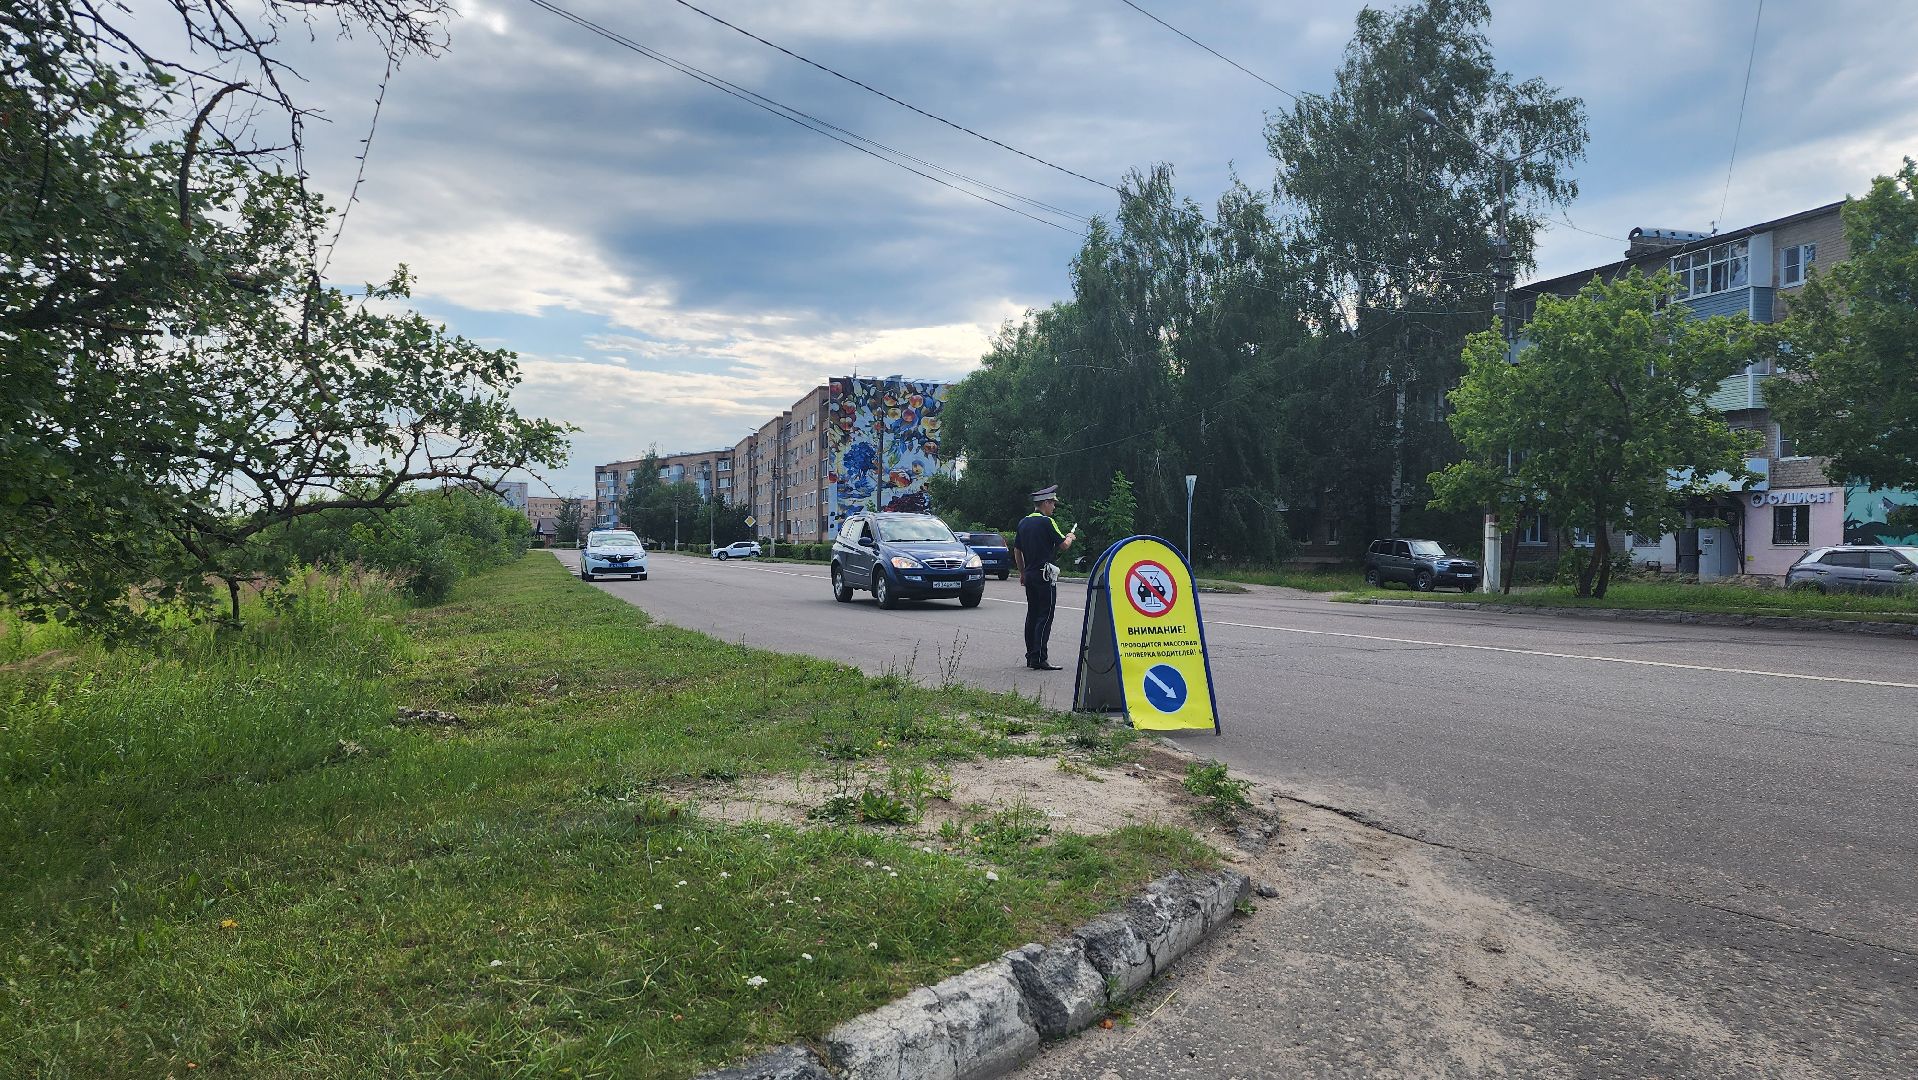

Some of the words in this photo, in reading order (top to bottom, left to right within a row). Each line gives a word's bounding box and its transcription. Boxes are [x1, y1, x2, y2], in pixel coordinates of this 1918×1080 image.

[1767, 492, 1833, 505] СУШИСЕТ
[1127, 624, 1187, 636] ВНИМАНИЕ!
[1120, 641, 1162, 649] ПРОВОДИТСЯ
[1157, 648, 1197, 657] ВОДИТЕЛЕЙ!
